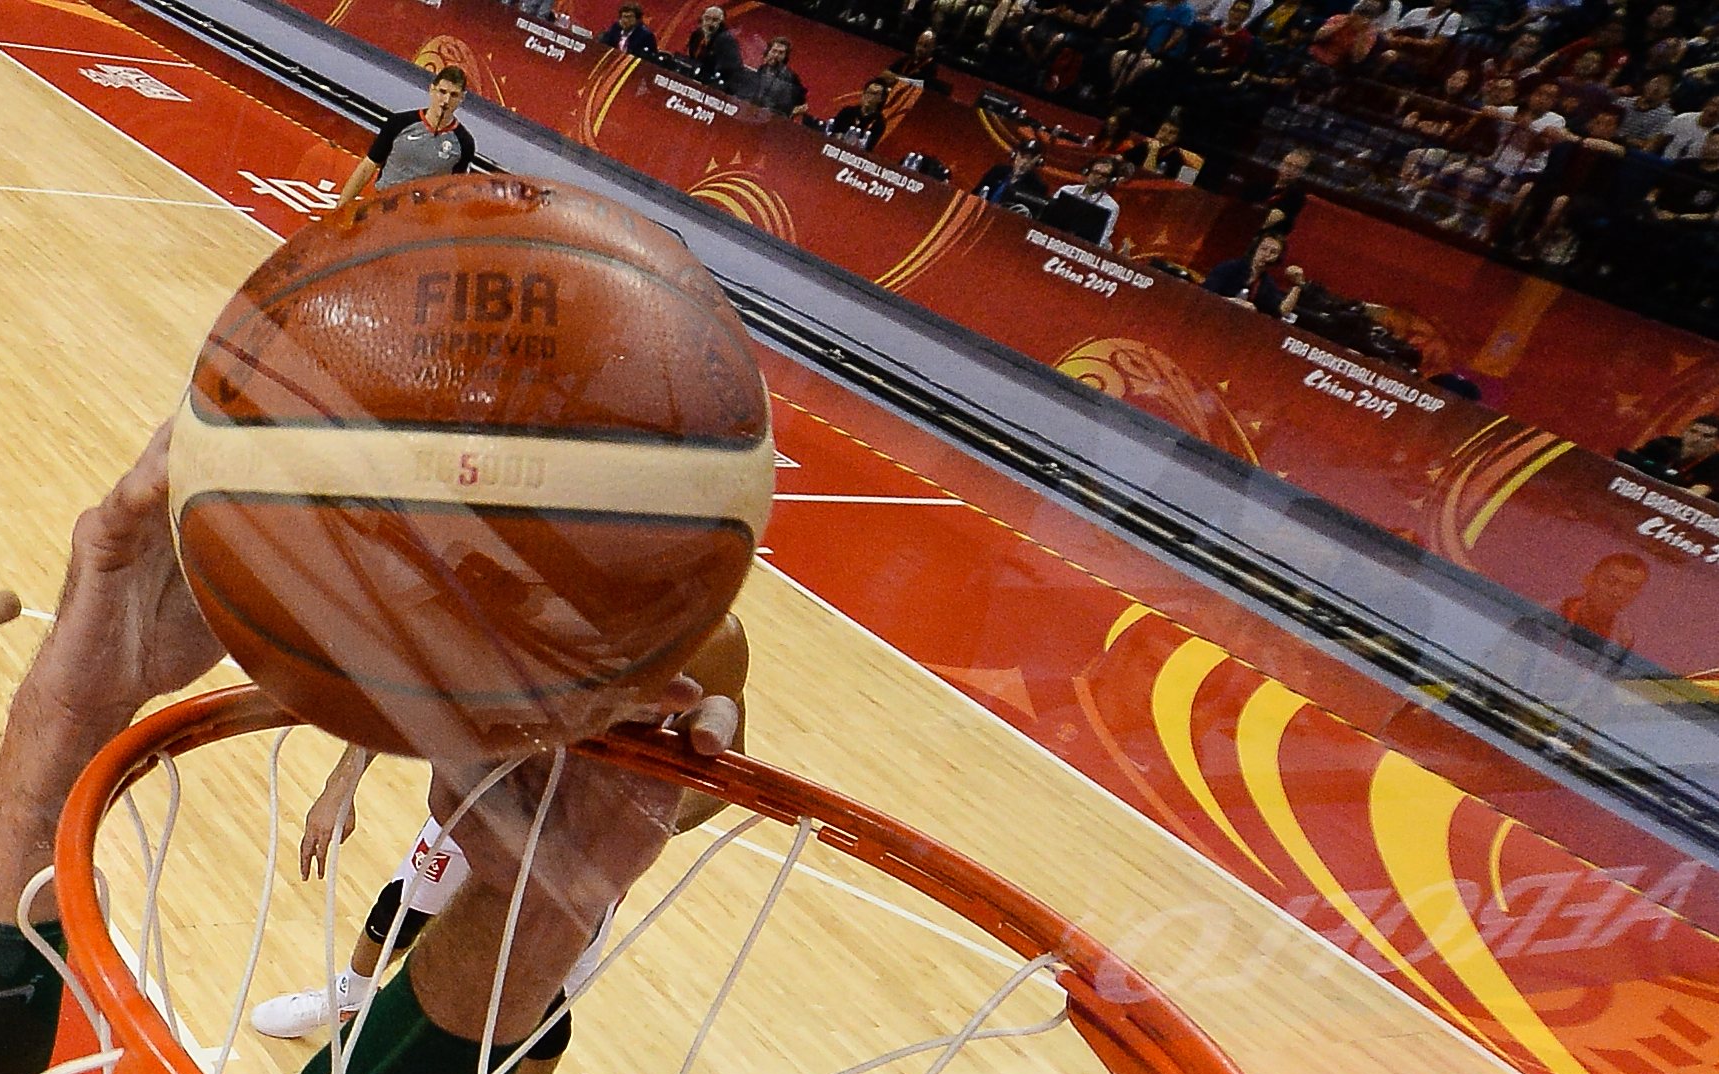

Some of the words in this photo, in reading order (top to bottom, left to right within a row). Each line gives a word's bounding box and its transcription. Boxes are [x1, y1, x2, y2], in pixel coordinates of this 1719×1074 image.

[414, 270, 558, 327] FIBA
[1043, 256, 1084, 284] China
[1083, 272, 1118, 299] 2019
[413, 332, 557, 361] APPROVED
[1282, 336, 1310, 357] FIBA
[1306, 347, 1378, 386] BASKETBALL
[1374, 374, 1420, 403] WORLD
[1415, 393, 1446, 413] CUP
[1303, 369, 1355, 402] China
[1355, 389, 1398, 420] 2019
[1636, 516, 1705, 556] China
